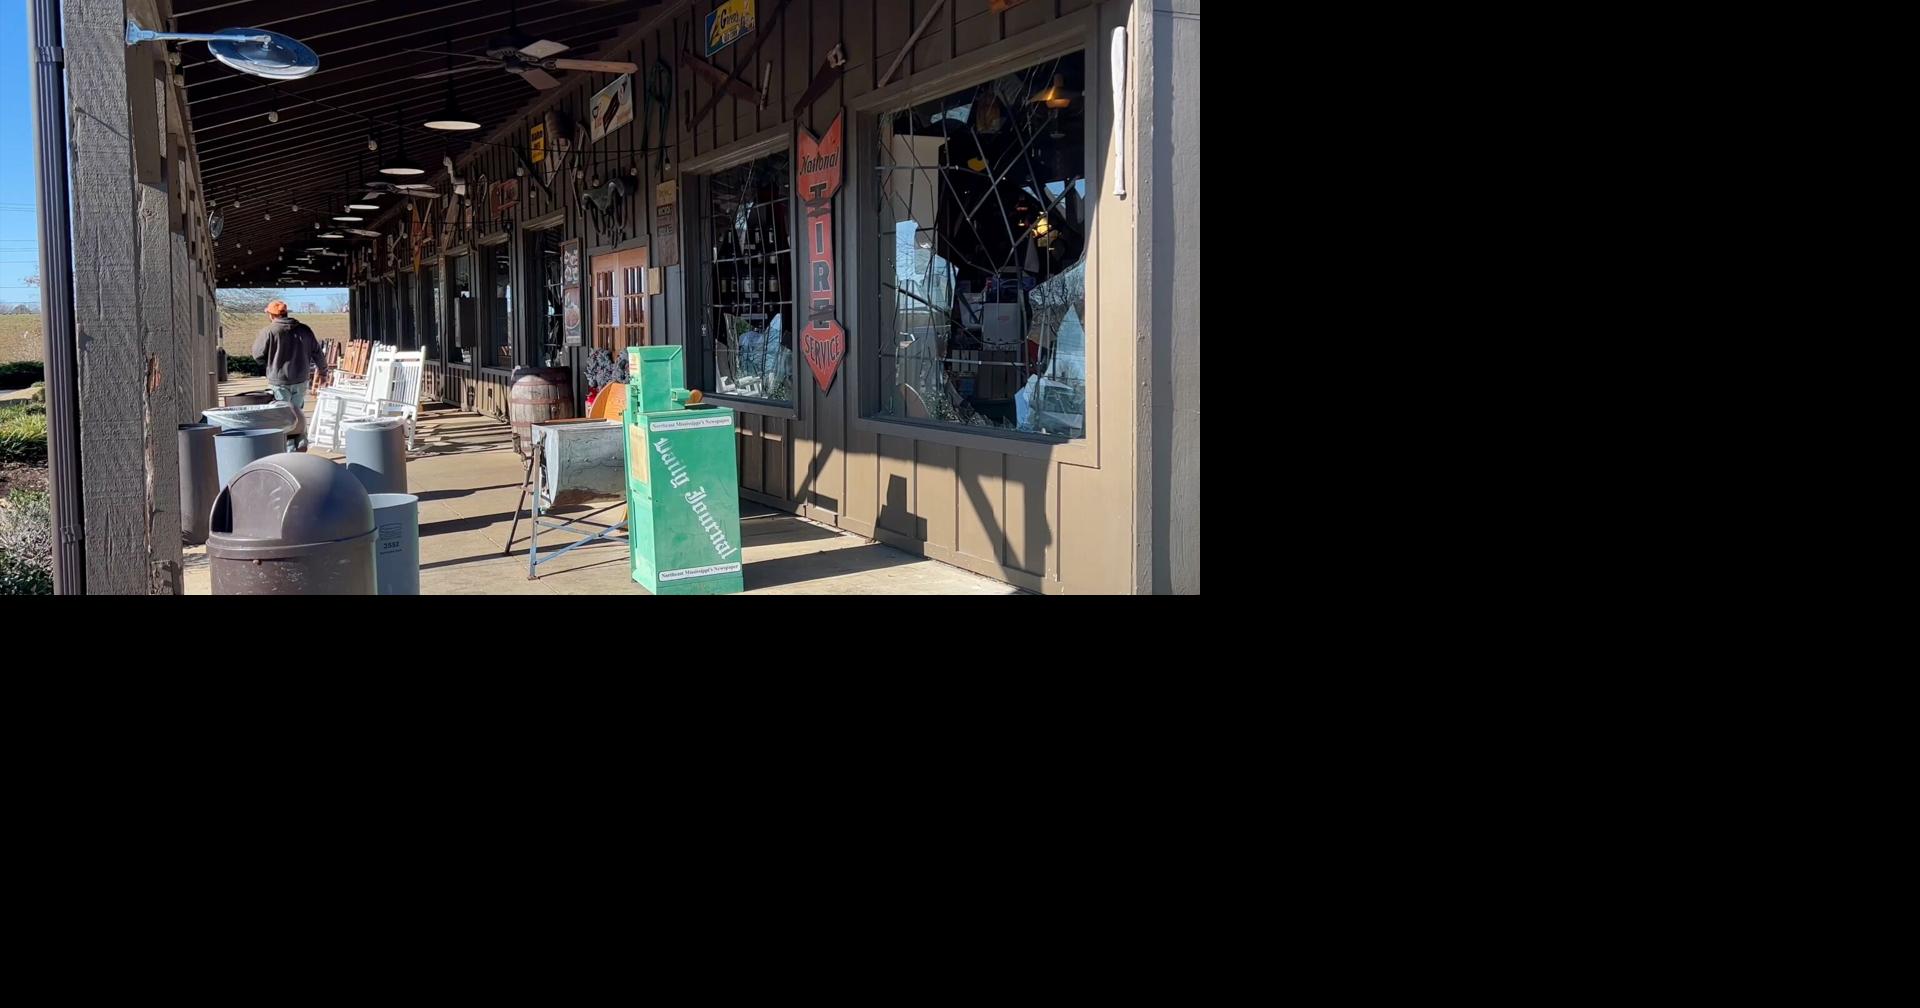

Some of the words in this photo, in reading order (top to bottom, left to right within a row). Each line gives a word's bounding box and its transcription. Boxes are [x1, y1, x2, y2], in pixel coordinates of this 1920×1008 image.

[799, 147, 840, 172] National
[808, 181, 832, 330] TIRE
[804, 334, 841, 369] SERVICE
[653, 437, 690, 489] Daily
[684, 486, 737, 560] Journal
[713, 563, 739, 573] Newspaper
